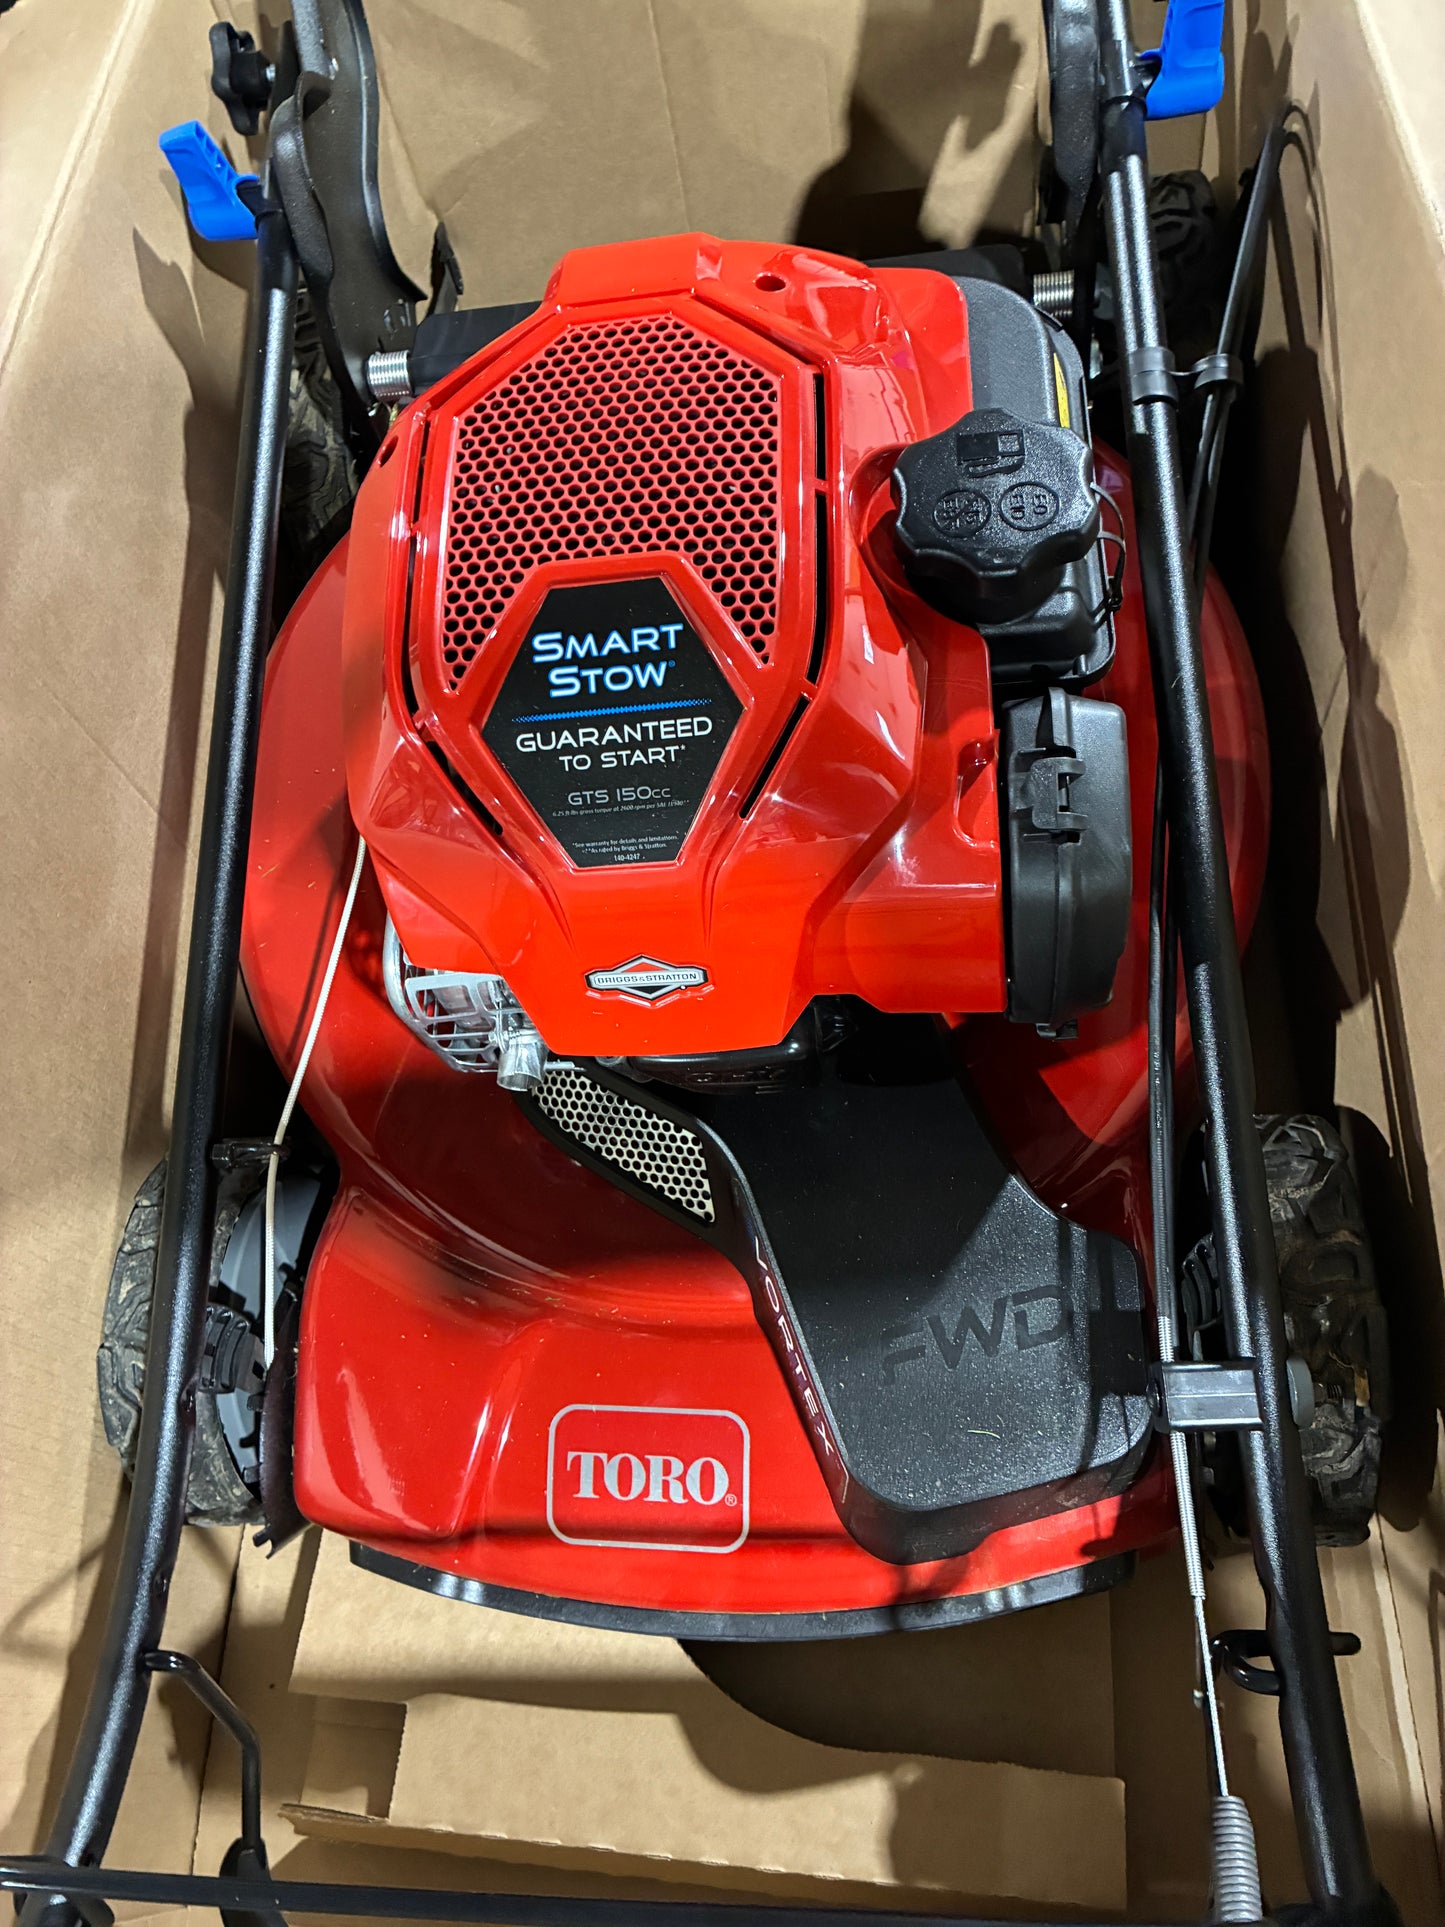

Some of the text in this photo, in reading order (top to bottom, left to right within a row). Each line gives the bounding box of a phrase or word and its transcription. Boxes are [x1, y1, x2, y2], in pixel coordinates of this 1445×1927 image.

[532, 623, 684, 663] SMART
[516, 716, 713, 753] GUARANTEED
[559, 754, 591, 772] TO
[567, 789, 609, 806] GTS
[754, 1235, 834, 1456] VORTEX
[881, 1285, 1074, 1385] FWD
